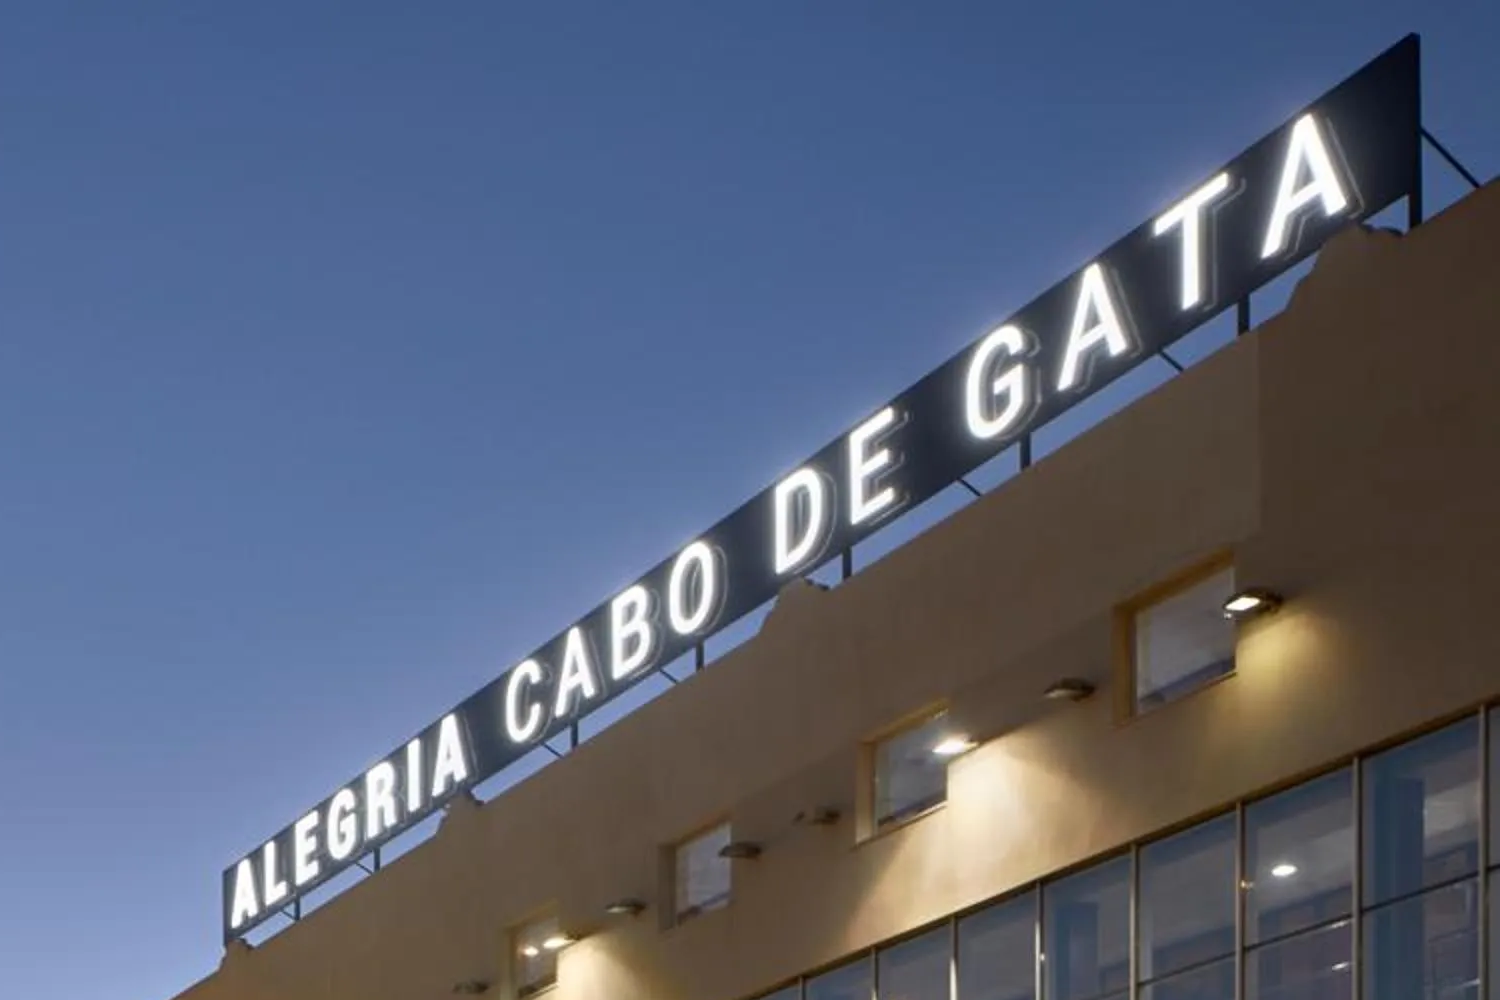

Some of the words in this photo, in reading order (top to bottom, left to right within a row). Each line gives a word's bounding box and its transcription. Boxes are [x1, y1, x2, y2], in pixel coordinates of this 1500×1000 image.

[230, 712, 469, 929] ALEGRIA
[504, 539, 716, 744] CABO
[773, 406, 896, 575] DE
[964, 112, 1349, 440] GATA
